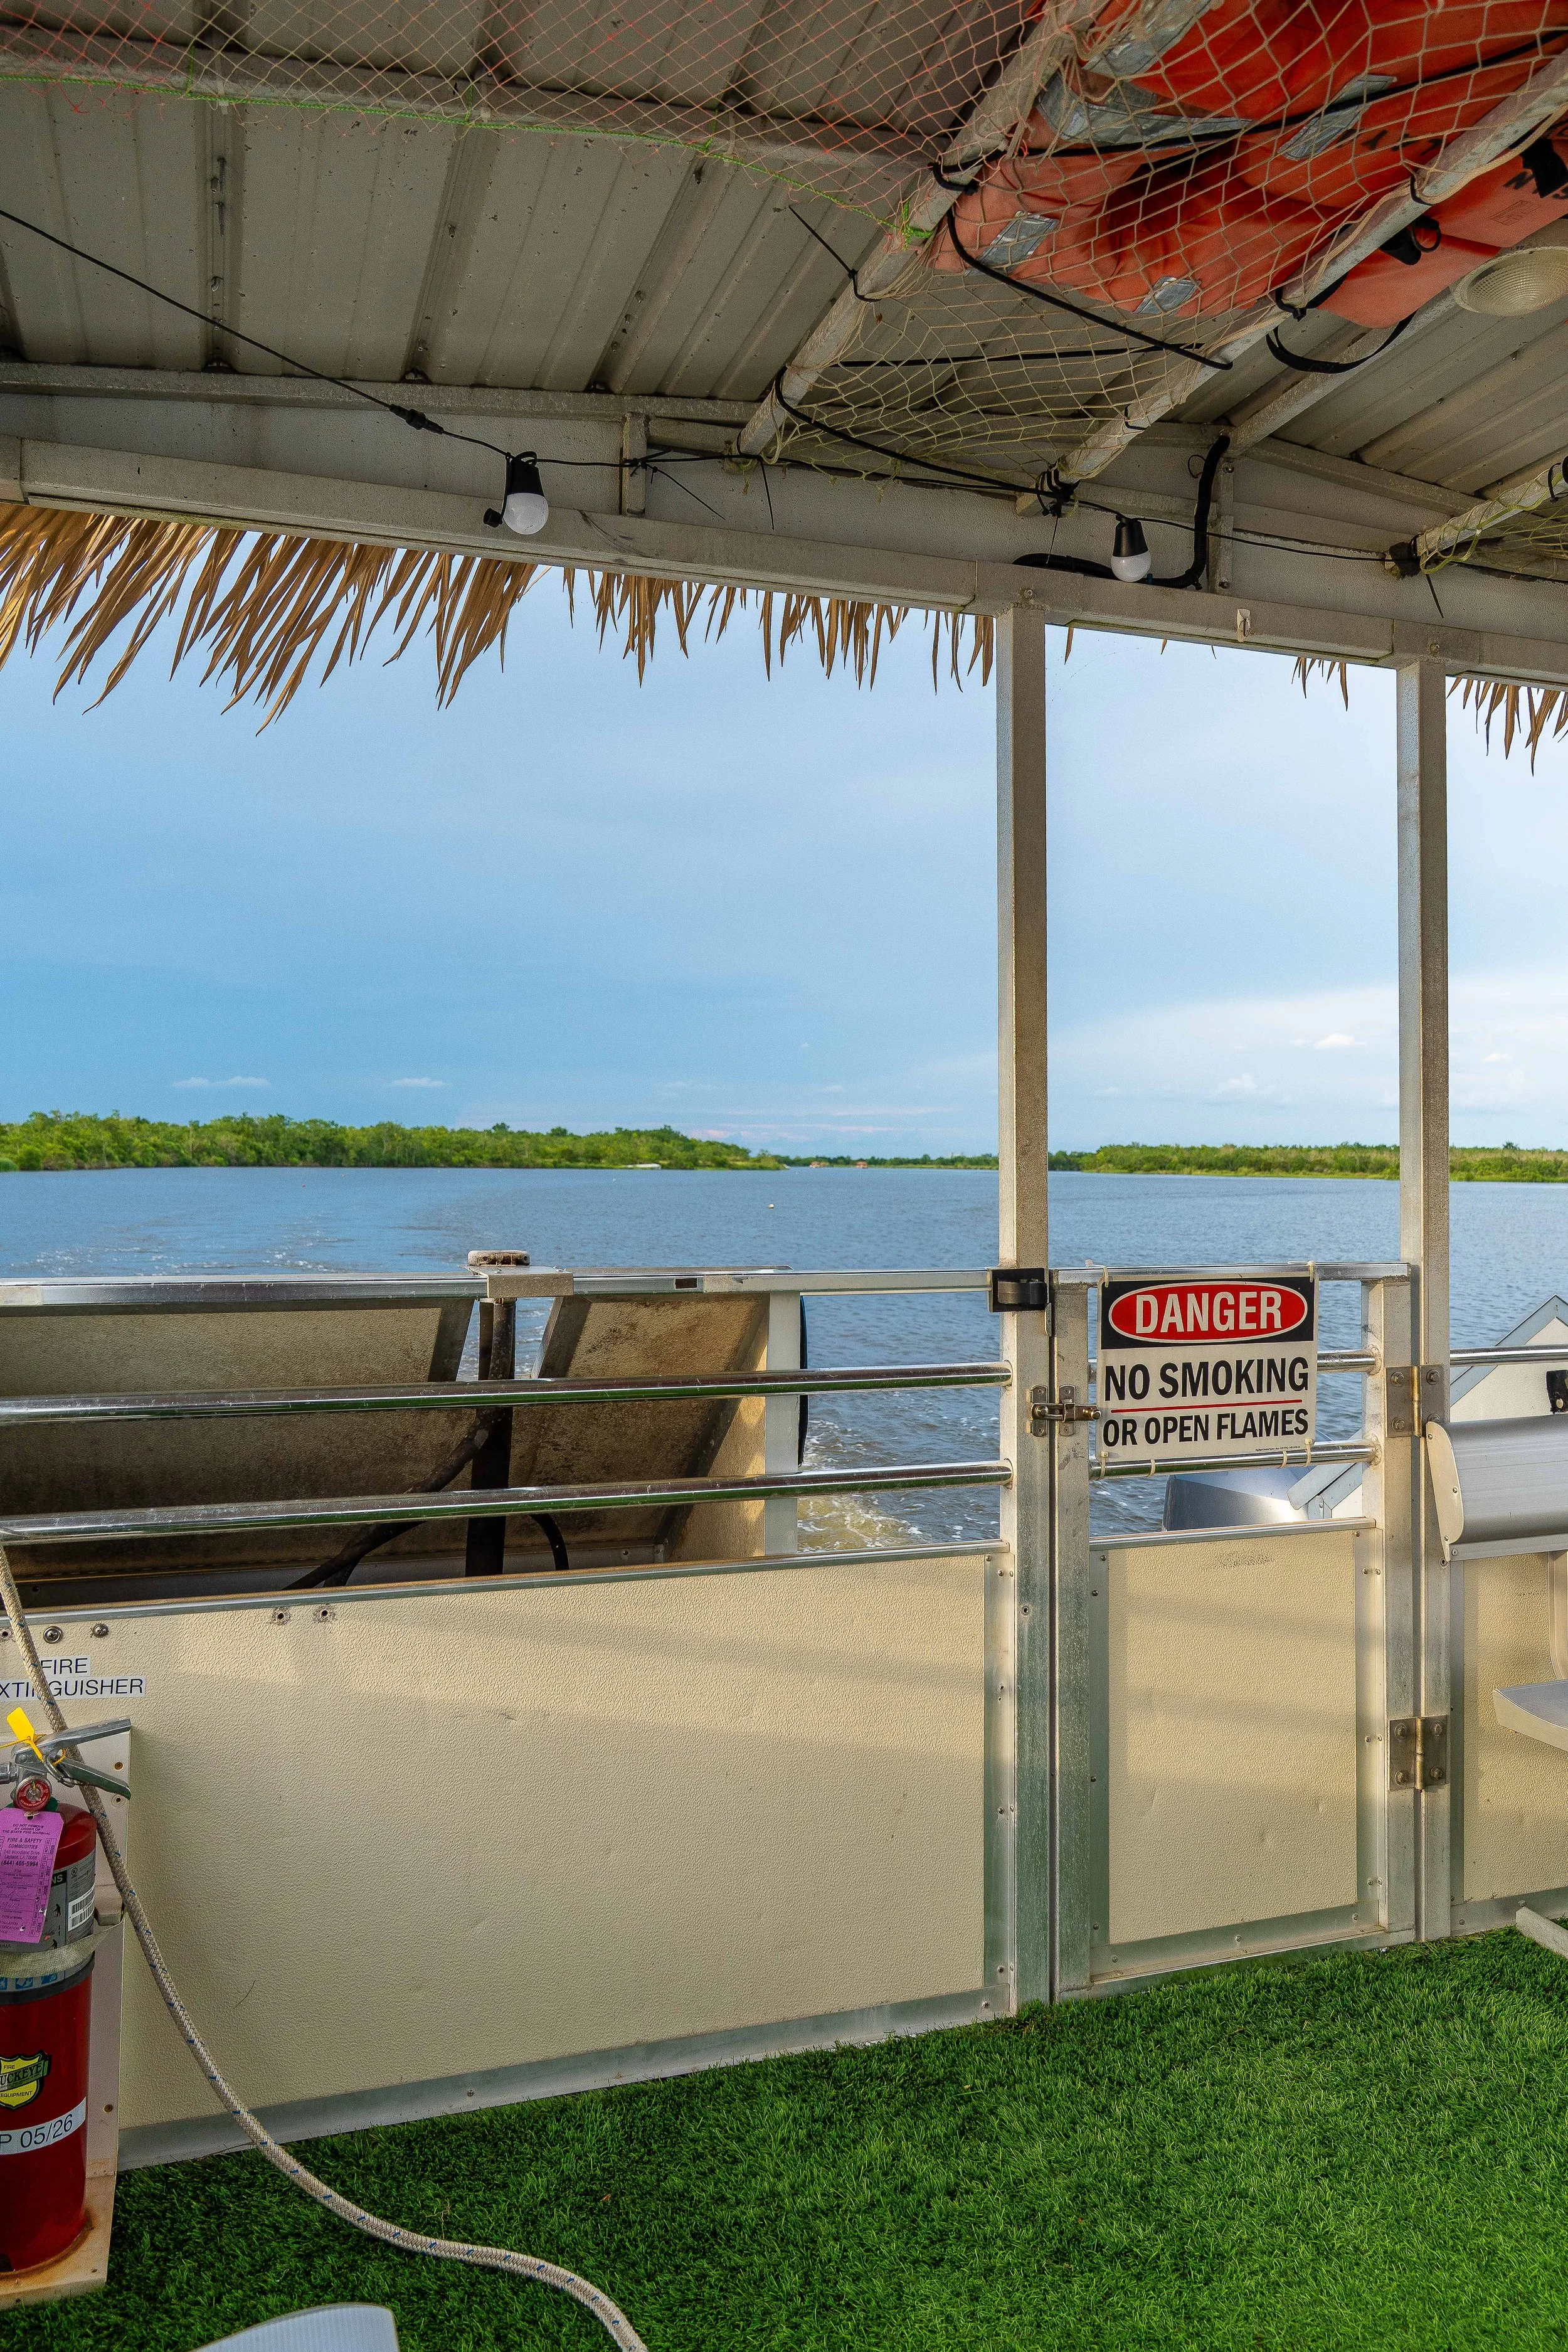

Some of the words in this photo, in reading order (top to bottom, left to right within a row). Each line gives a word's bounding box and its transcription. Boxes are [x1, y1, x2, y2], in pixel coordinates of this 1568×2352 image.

[1136, 1291, 1282, 1333] DANGER
[1105, 1364, 1150, 1401] NO
[1159, 1357, 1308, 1399] SMOKING
[1103, 1418, 1137, 1447] OR
[1144, 1414, 1209, 1443] OPEN
[1217, 1409, 1308, 1440] FLAMES
[40, 1657, 88, 1675] FIRE
[0, 1678, 143, 1698] XTIGUISHER
[20, 2114, 73, 2148] 05/26
